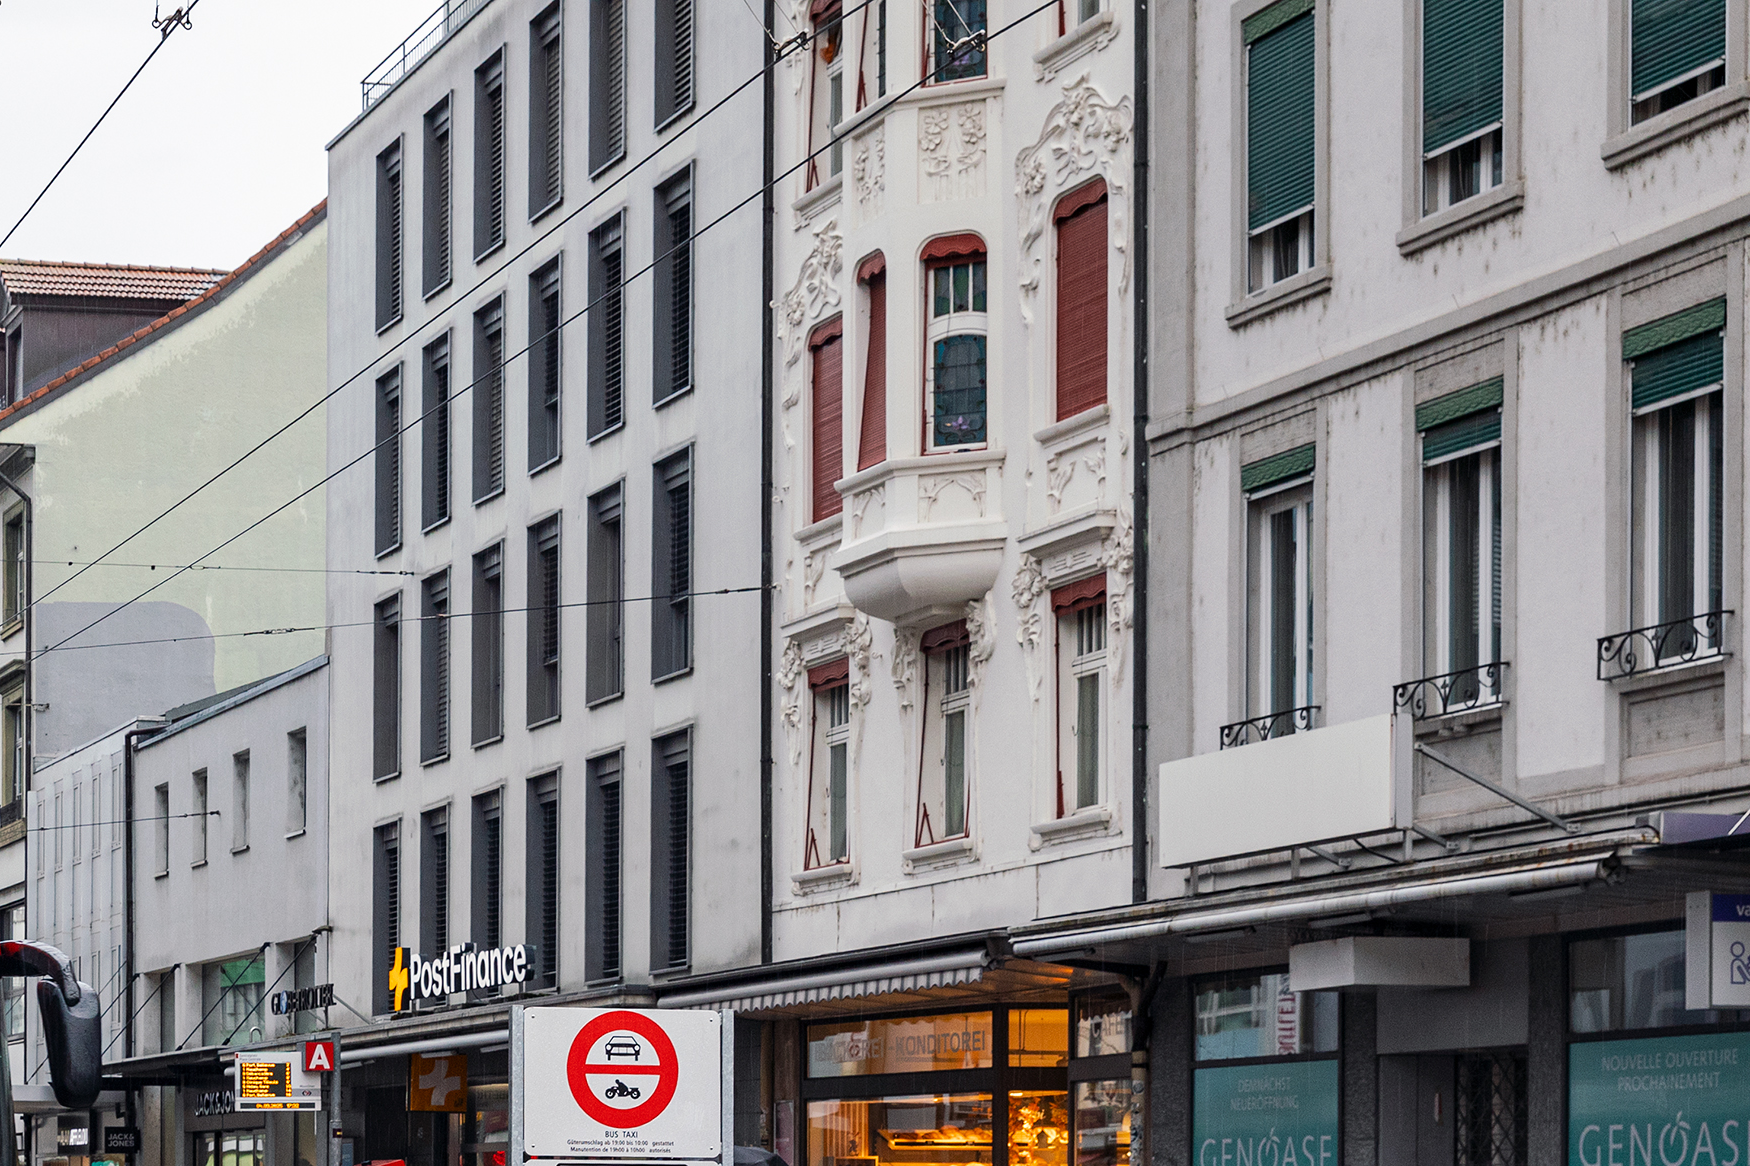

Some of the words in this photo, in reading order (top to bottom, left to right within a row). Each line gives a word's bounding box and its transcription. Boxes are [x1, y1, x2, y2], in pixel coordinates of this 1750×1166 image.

[410, 942, 526, 1000] PostFinance
[309, 1044, 330, 1069] A
[1602, 1054, 1661, 1071] NOUVELLE
[1618, 1073, 1720, 1092] PROCHAINEMENT
